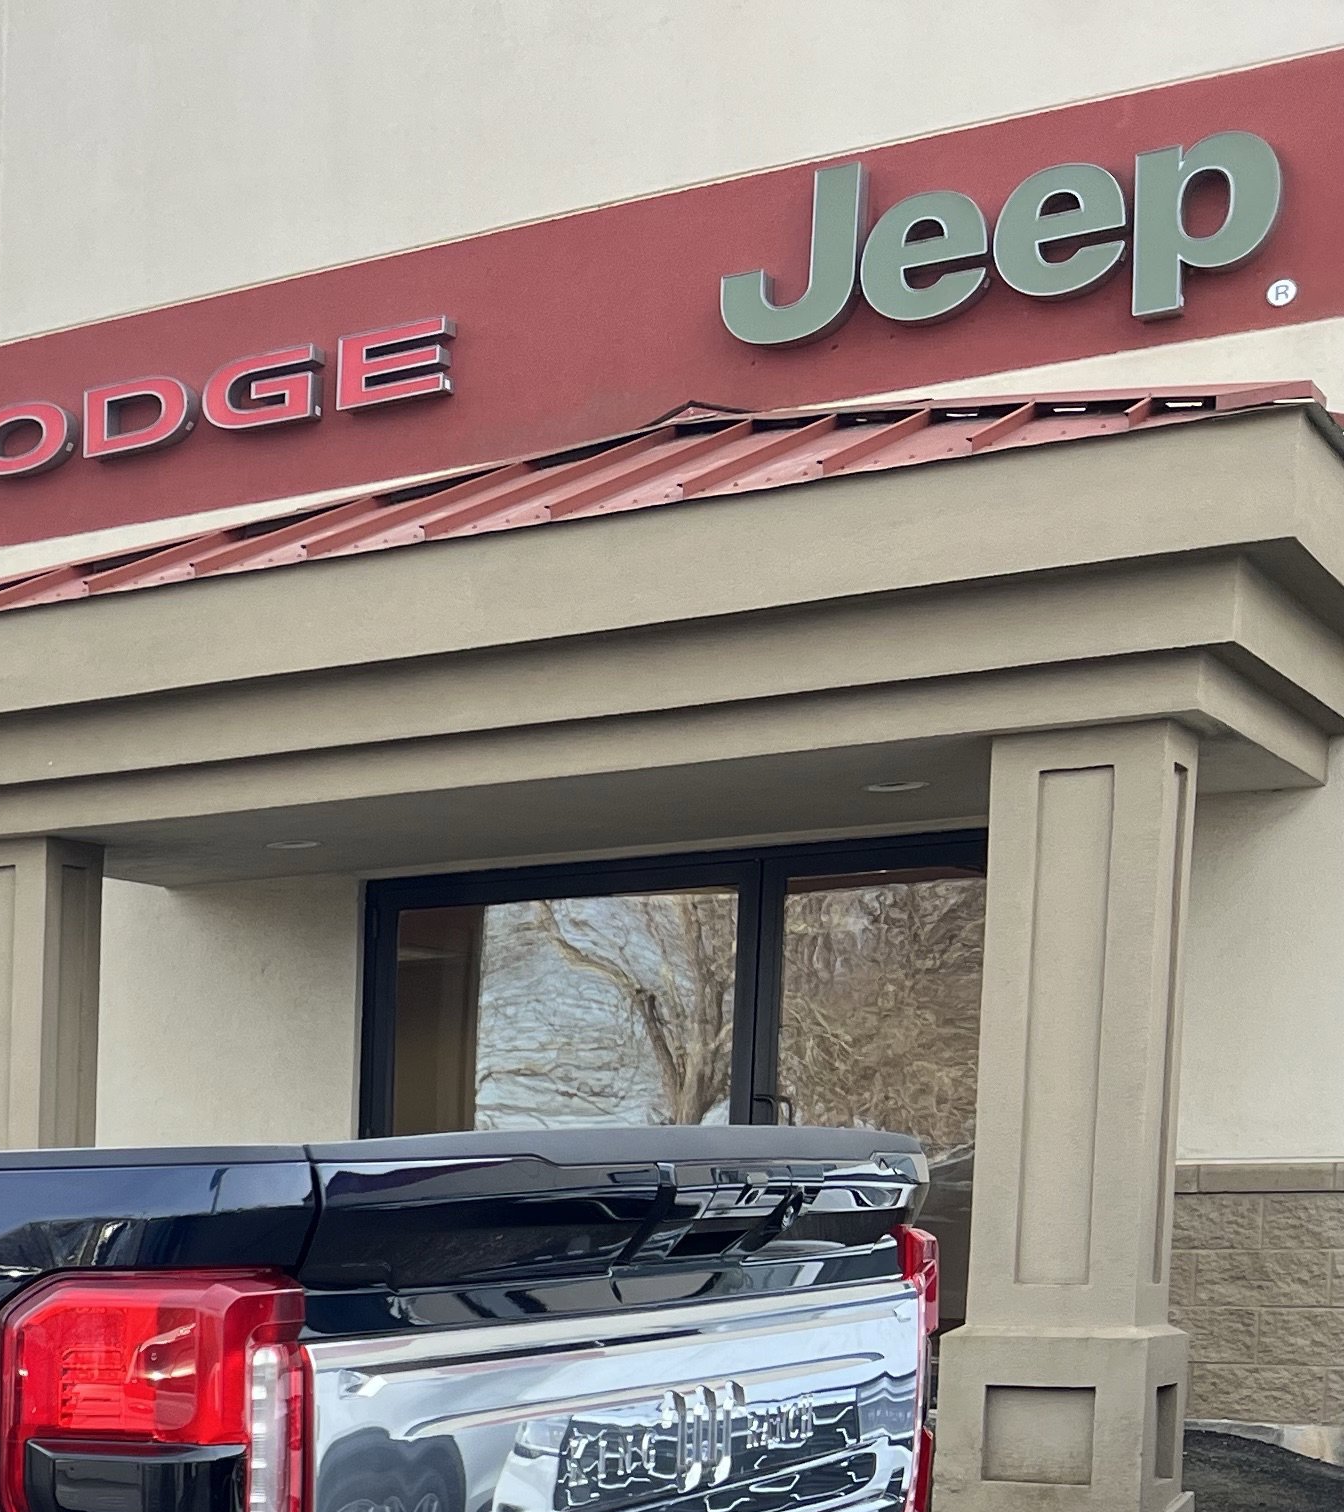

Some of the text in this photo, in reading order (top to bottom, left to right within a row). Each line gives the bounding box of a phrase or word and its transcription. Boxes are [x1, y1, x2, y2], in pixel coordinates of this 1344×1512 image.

[720, 130, 1283, 346] Jeep
[567, 1395, 813, 1486] KING RANCH
